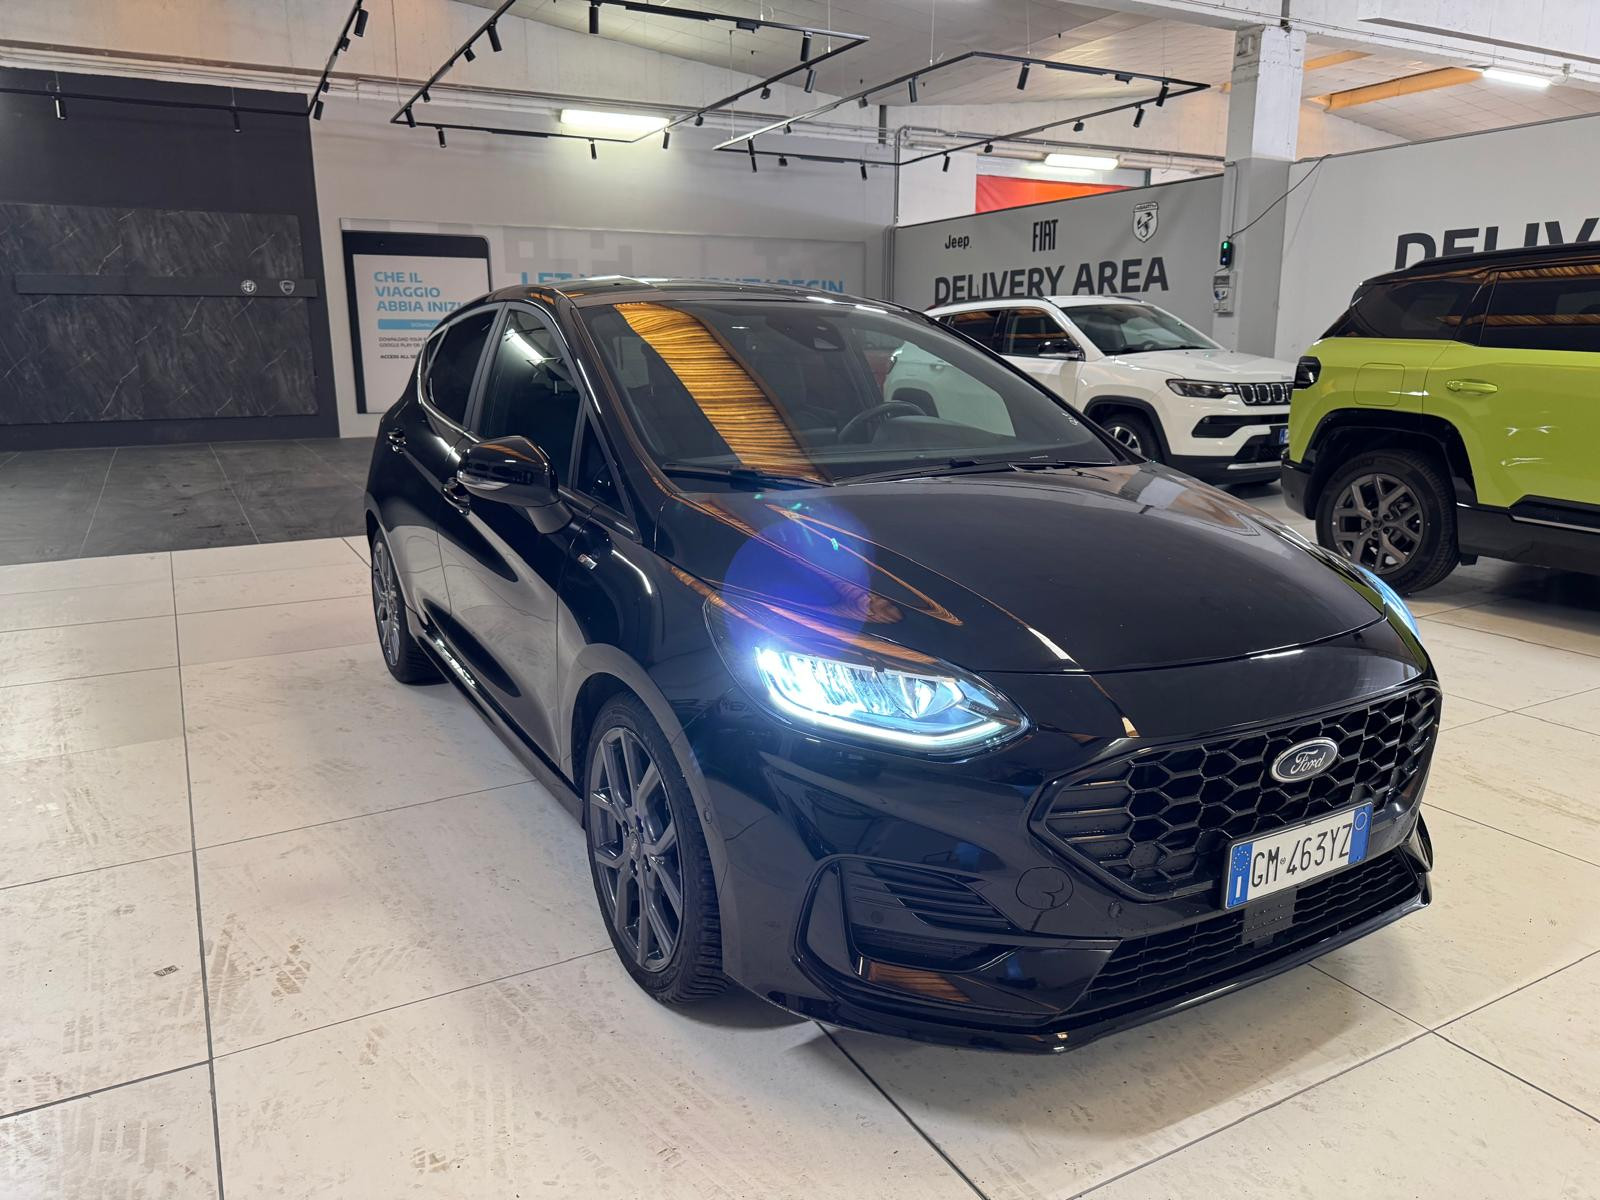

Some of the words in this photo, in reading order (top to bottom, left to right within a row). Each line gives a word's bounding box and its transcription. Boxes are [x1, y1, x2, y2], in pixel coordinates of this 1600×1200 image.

[945, 235, 970, 249] Jeep
[1032, 219, 1059, 252] FIAT
[374, 271, 405, 282] CHE
[409, 272, 422, 283] IL
[934, 265, 1066, 306] DELIVERY
[1072, 257, 1169, 296] AREA
[375, 286, 440, 298] VIAGGIO
[377, 301, 424, 312] ABBIA
[1290, 748, 1327, 775] Ford
[1252, 846, 1280, 888] GM
[1286, 822, 1353, 876] 463YZ
